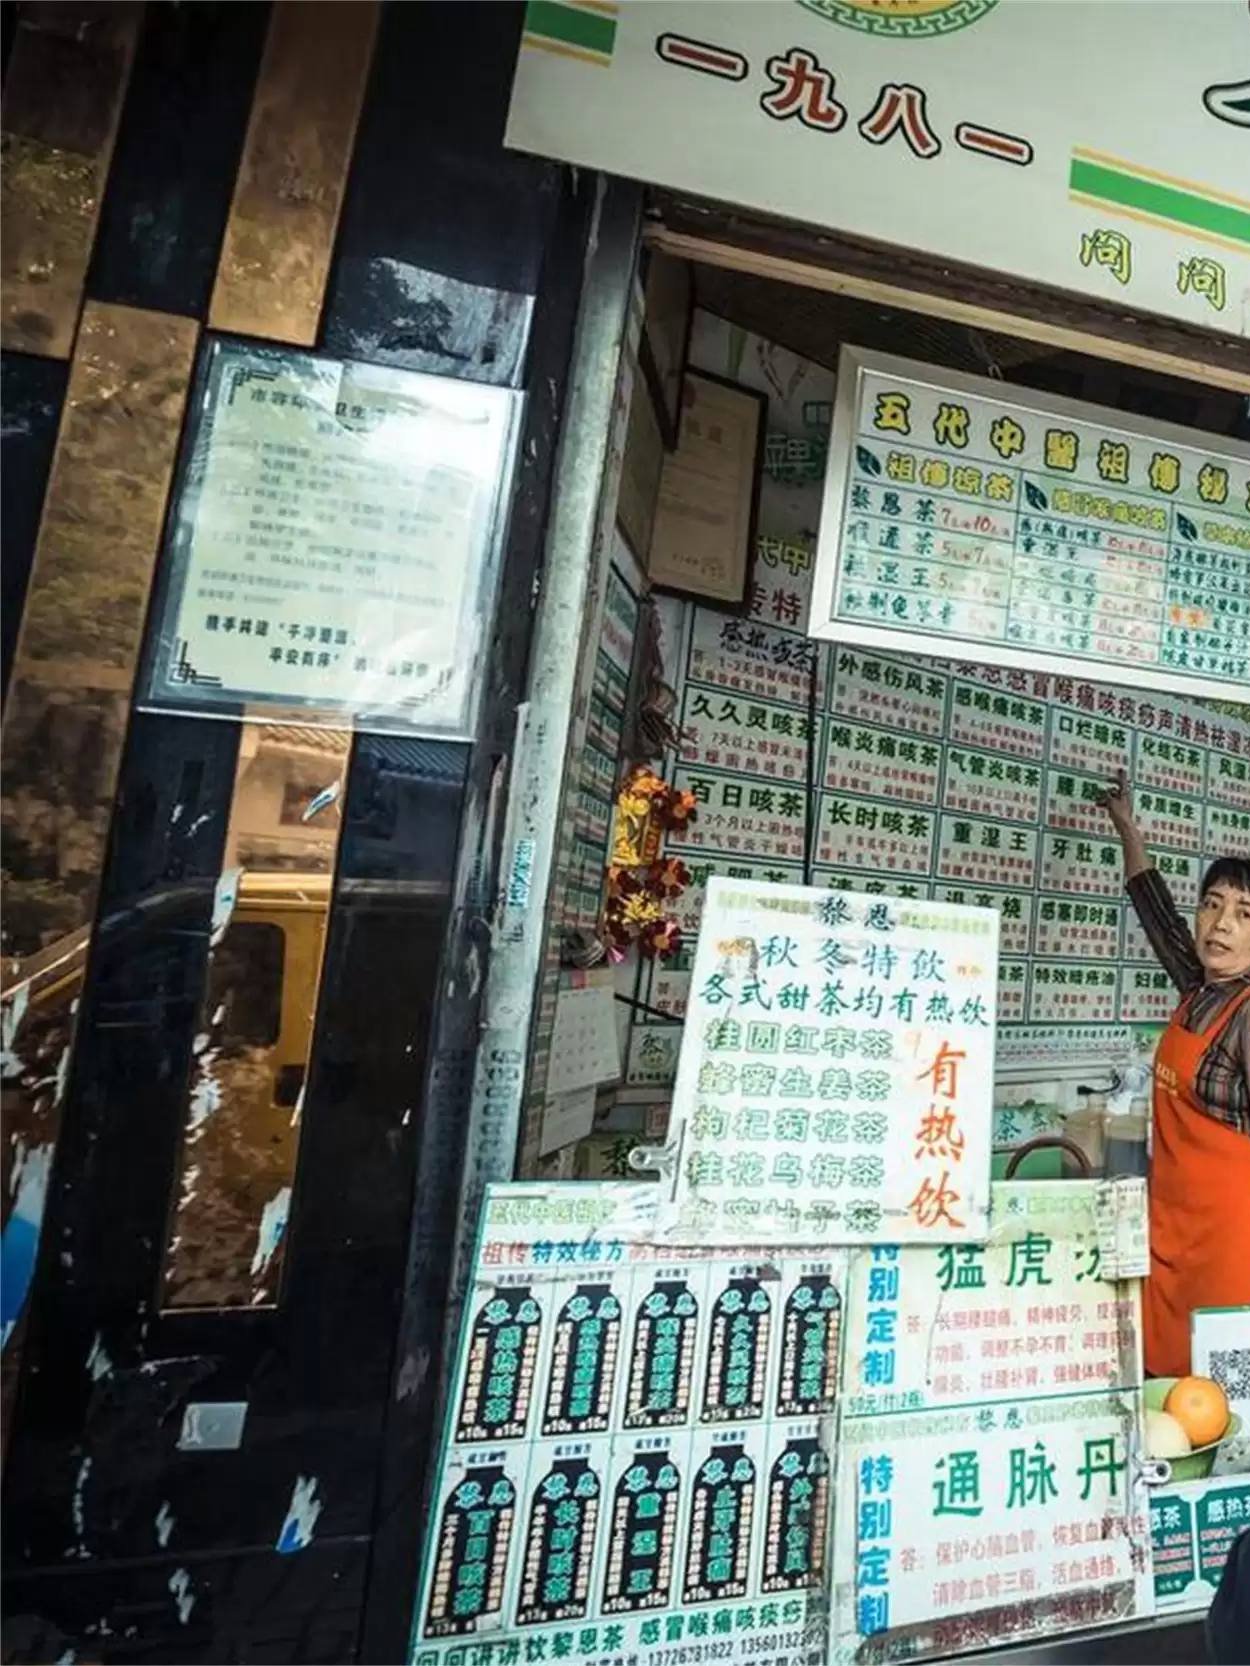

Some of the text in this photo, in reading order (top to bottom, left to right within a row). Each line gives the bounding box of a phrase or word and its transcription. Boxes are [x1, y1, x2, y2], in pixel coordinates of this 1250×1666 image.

[657, 33, 1032, 166] 一九八一
[688, 776, 803, 820] 百日咳茶
[828, 800, 930, 839] 长时咳茶
[699, 972, 991, 1029] 各式甜茶均有热饮
[702, 1015, 896, 1062] 桂圆红枣茶
[690, 1102, 889, 1145] 枸杞菊花茶
[905, 1038, 968, 1231] 有热饮
[684, 1149, 886, 1190] 桂花乌梅茶
[931, 1438, 1128, 1518] 通脉丹
[855, 1455, 894, 1638] 特别定制
